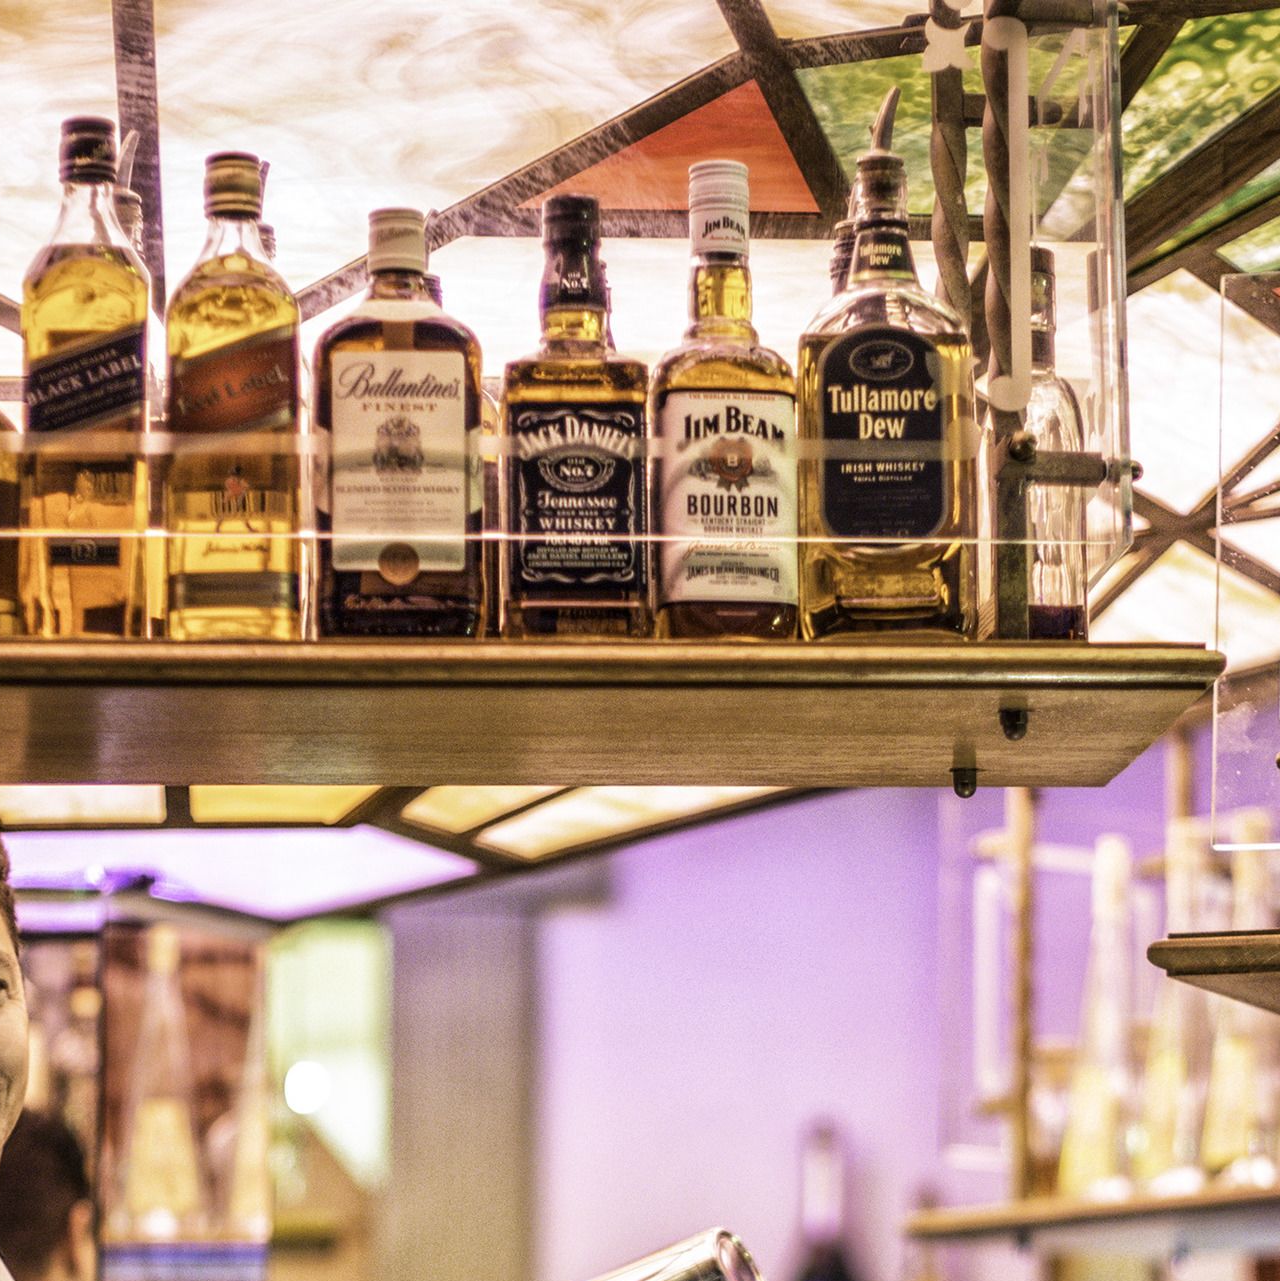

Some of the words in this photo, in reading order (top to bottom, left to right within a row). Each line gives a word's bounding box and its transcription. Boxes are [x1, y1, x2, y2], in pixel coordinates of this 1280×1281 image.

[703, 219, 721, 239] JIM
[859, 243, 903, 257] Tullamore
[869, 254, 890, 266] Dew
[26, 374, 84, 406] BLACK
[86, 354, 142, 385] LABEL
[335, 361, 461, 400] Ballantine's
[362, 402, 439, 413] FINEST
[827, 384, 937, 414] Tullamore
[677, 413, 720, 453] JIM
[725, 404, 786, 452] BEAM
[858, 412, 906, 440] Dew
[518, 423, 563, 462] JACK
[564, 414, 638, 461] DANIEL'S
[841, 463, 873, 475] IRISH
[875, 461, 926, 473] WHISKEY
[536, 489, 618, 510] Tennessee
[687, 493, 779, 518] BOURBON
[538, 517, 617, 531] WHISKEY
